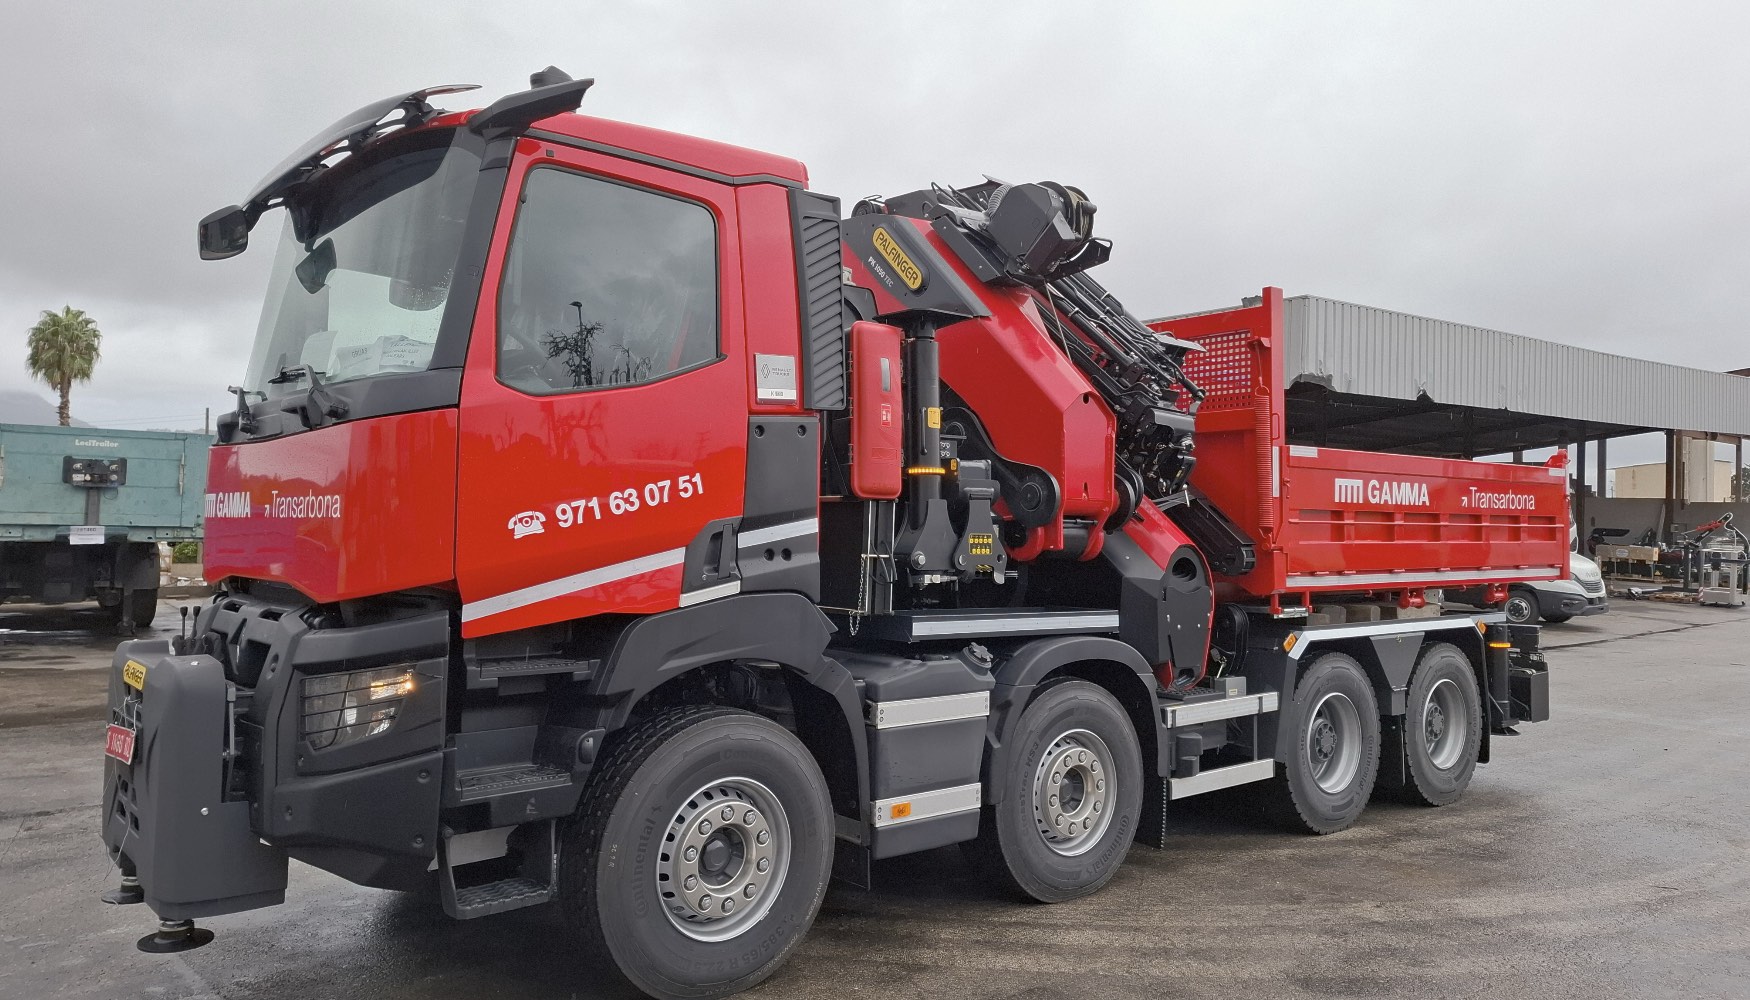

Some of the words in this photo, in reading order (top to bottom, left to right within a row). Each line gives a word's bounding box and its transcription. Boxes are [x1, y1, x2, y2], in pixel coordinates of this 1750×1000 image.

[867, 256, 875, 267] PK
[883, 274, 894, 287] TEC
[875, 231, 919, 286] PALFINGER
[217, 491, 251, 518] GAMMA
[271, 489, 341, 519] Transarbona
[555, 496, 602, 528] 971
[609, 488, 640, 515] 63
[644, 479, 671, 507] 07
[678, 472, 704, 498] 51
[1367, 480, 1430, 506] GAMMA
[1469, 486, 1536, 510] Transarbona
[1026, 741, 1039, 769] HS3
[1358, 734, 1375, 791] Continental
[1092, 814, 1130, 873] Continental
[632, 817, 658, 917] Continental
[741, 926, 785, 964] 385/65
